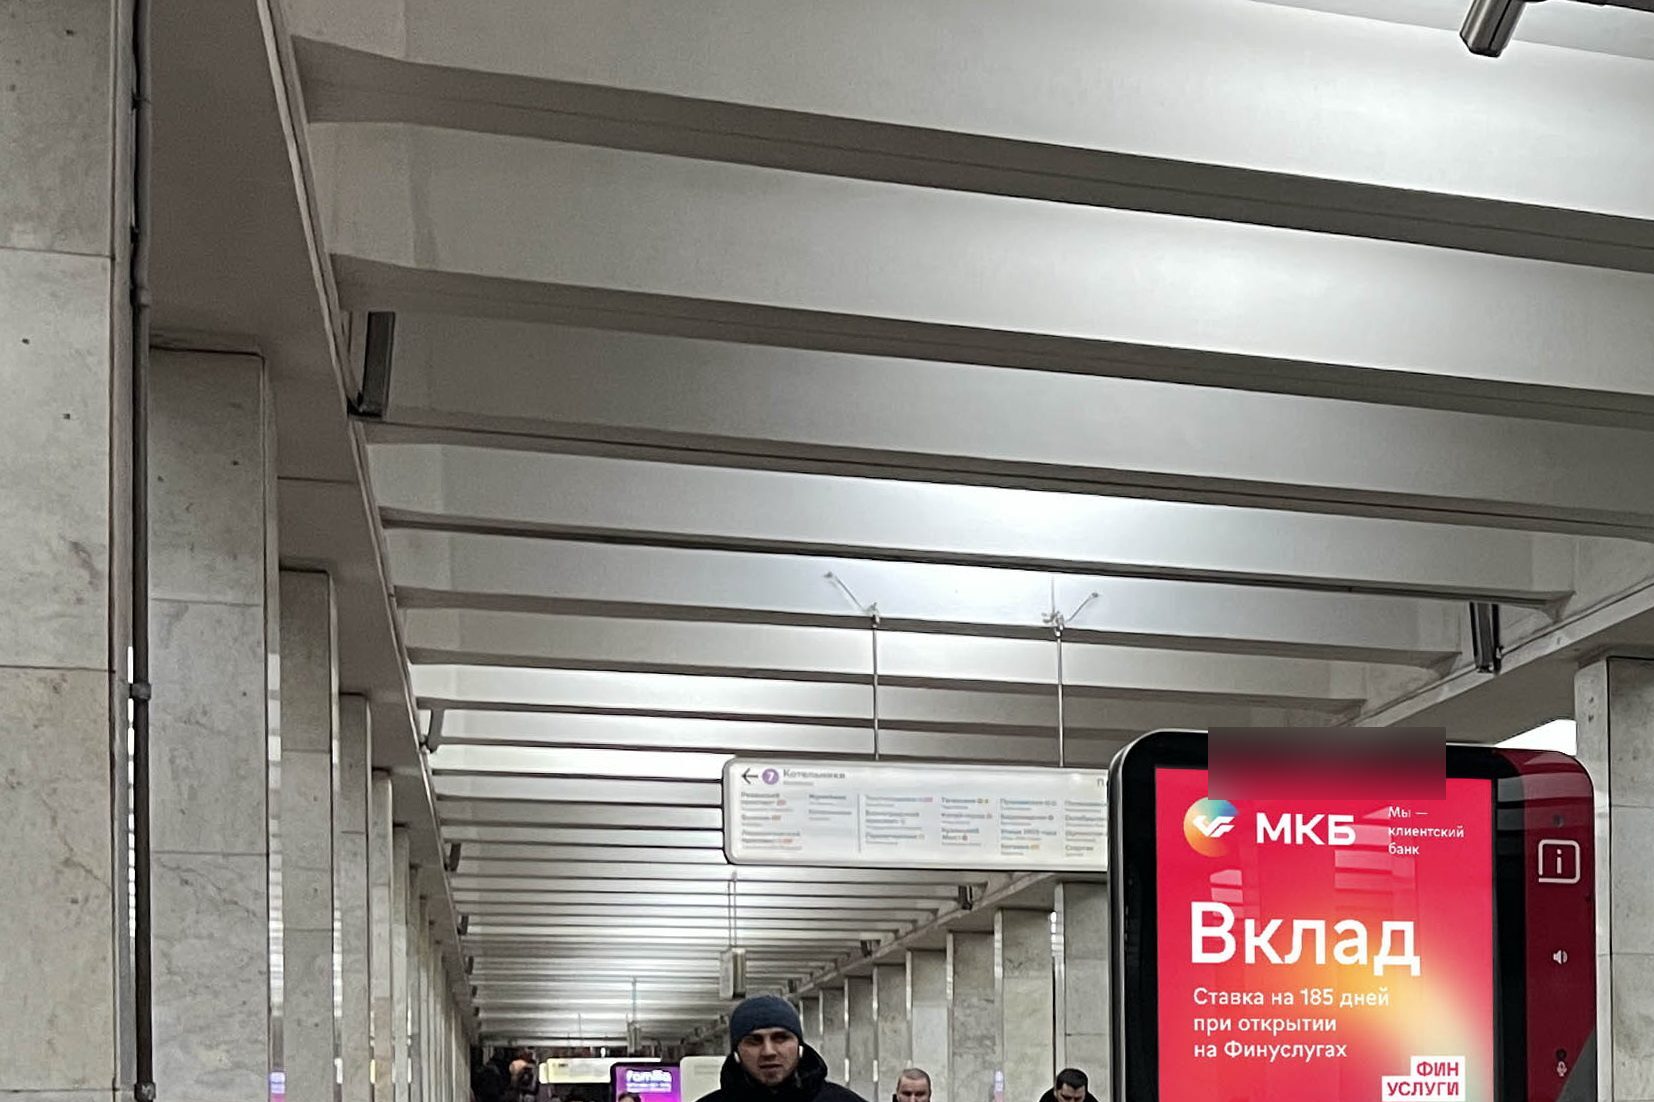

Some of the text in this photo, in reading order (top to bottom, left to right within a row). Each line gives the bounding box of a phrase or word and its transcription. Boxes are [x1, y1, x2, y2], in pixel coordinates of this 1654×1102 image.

[1388, 806, 1411, 818] Мы
[1256, 812, 1357, 846] МКБ
[1388, 825, 1464, 838] клиентский
[1388, 843, 1420, 855] банк
[1190, 901, 1422, 976] Вклад
[1193, 986, 1389, 1008] Ставка на 185 дней
[1194, 1017, 1337, 1036] при открытии
[1194, 1040, 1348, 1063] на Финуслугах
[1416, 1061, 1459, 1077] ФИН
[1386, 1080, 1459, 1097] УСЛУГИ
